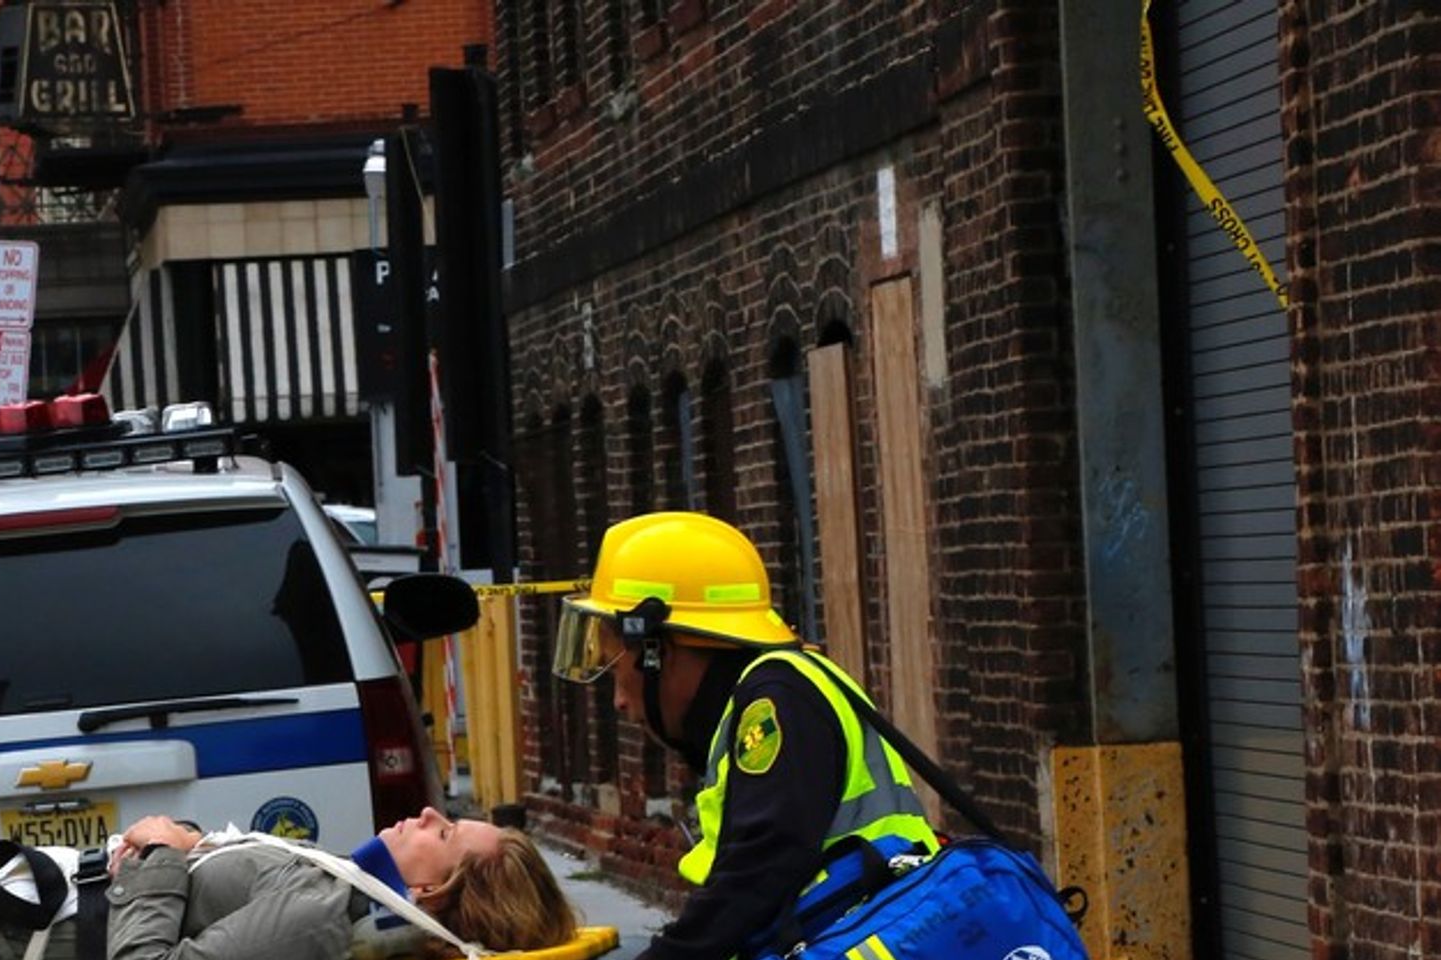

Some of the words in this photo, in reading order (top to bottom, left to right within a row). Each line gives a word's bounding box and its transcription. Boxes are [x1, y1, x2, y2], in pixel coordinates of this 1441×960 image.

[38, 9, 111, 52] BAR
[30, 79, 126, 114] GRILL
[1209, 196, 1252, 248] CROSS
[3, 249, 23, 267] NO
